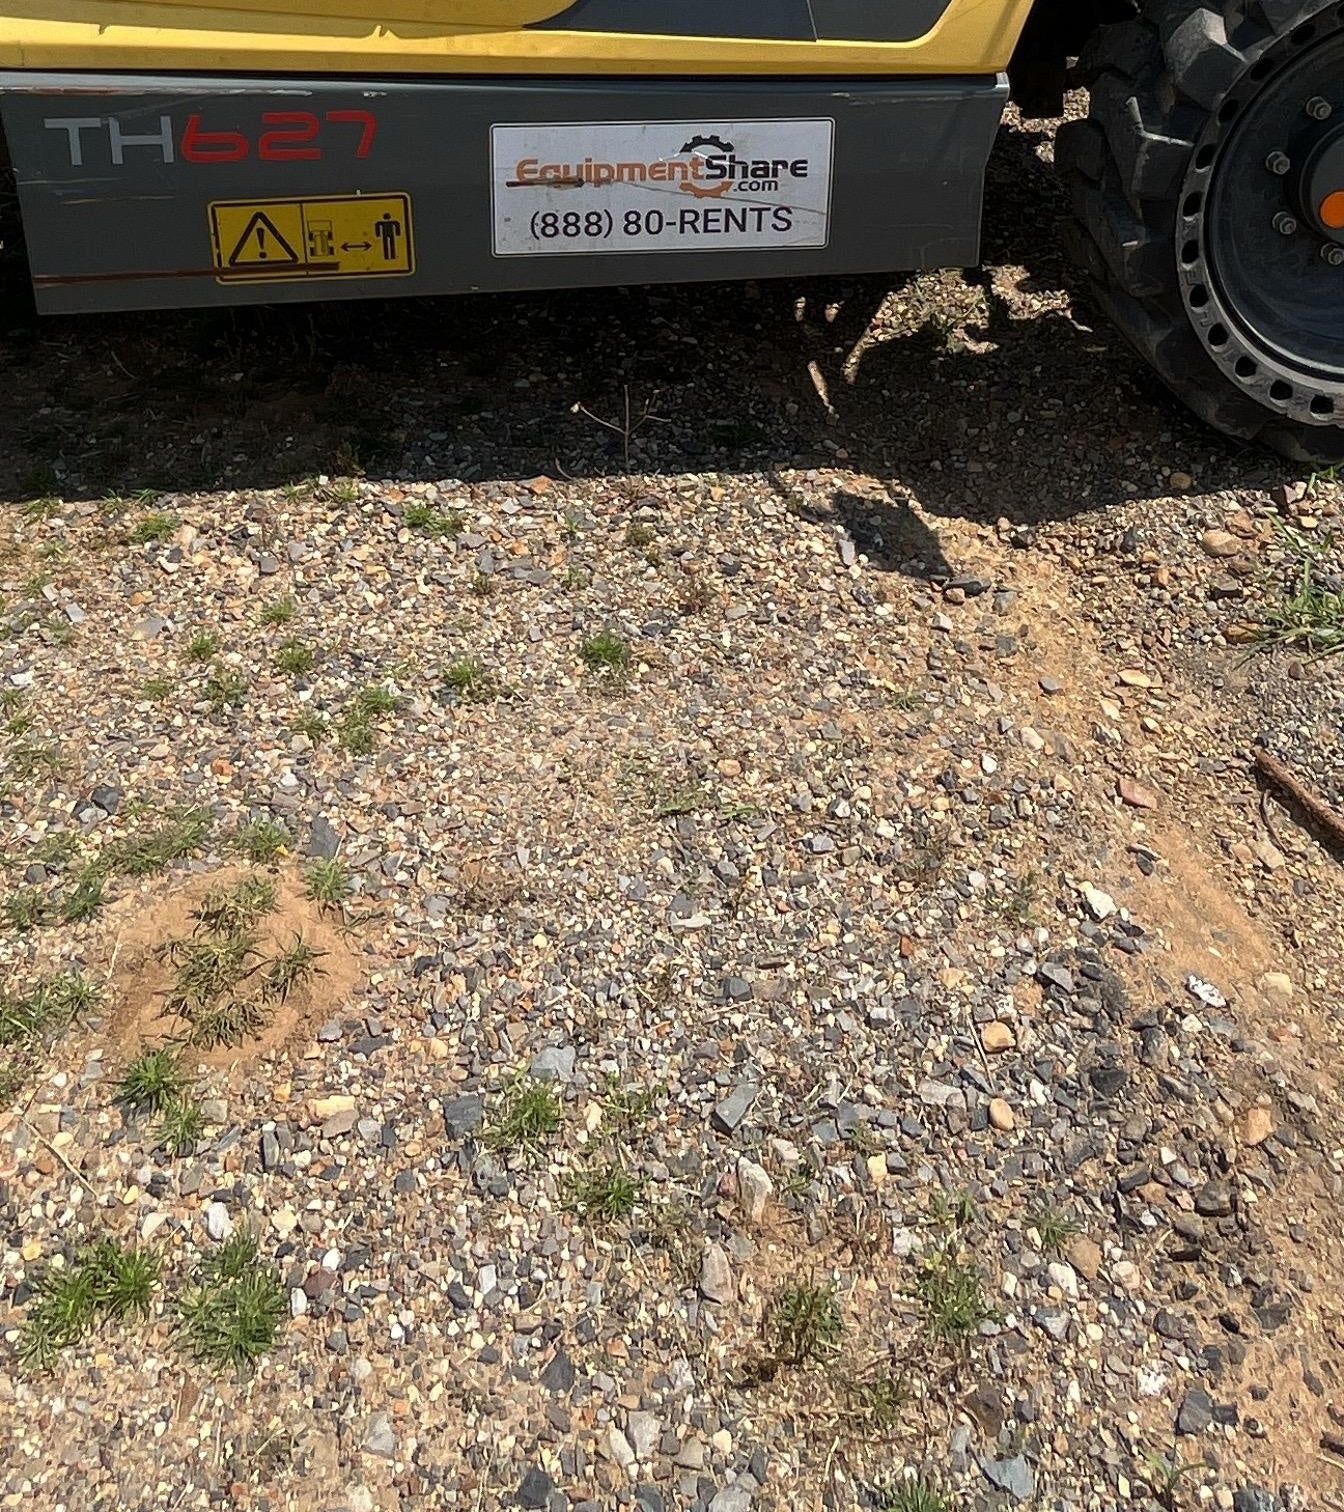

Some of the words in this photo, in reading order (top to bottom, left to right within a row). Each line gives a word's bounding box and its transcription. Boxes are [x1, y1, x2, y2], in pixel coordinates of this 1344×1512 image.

[44, 109, 378, 166] TH627
[514, 154, 809, 187] EquipmentShare
[732, 178, 779, 192] .com
[530, 208, 614, 241] (888)
[622, 206, 794, 236] 80-RENTS
